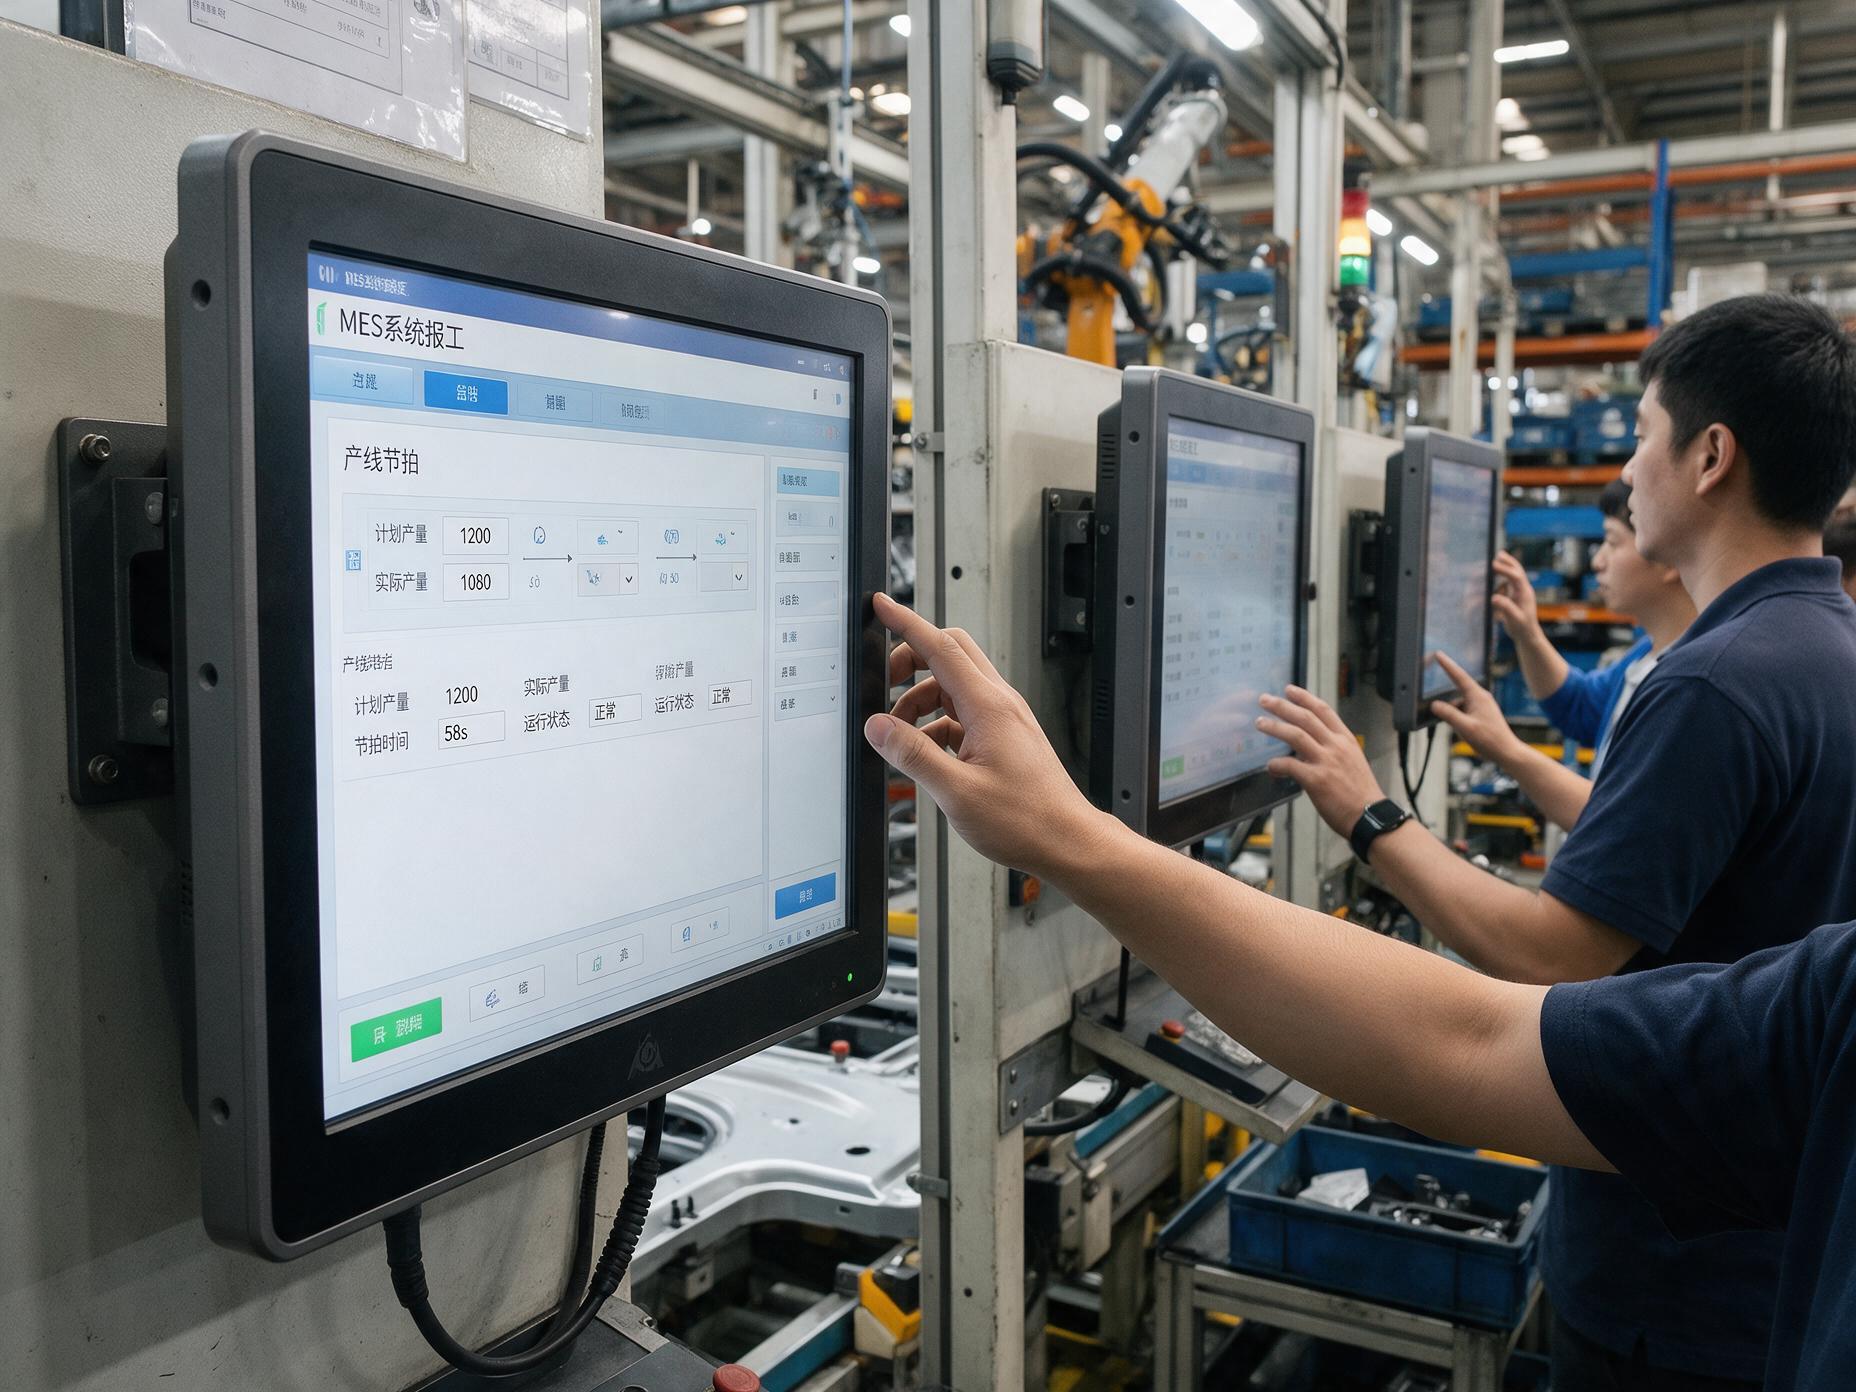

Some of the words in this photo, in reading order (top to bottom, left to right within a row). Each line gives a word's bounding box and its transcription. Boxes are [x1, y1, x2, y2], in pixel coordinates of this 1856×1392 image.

[340, 308, 465, 350] MES系统报工
[344, 444, 419, 475] 产线节拍
[375, 523, 428, 544] 计划产量
[460, 527, 491, 544] 1200
[375, 571, 428, 593] 实际产量
[461, 573, 492, 591] 1080
[354, 692, 410, 716] 计划产量
[445, 685, 479, 705] 1200
[524, 674, 570, 697] 实际产量
[654, 692, 695, 715] 运行状态
[711, 686, 731, 705] 正常
[523, 709, 571, 733] 运行状态
[594, 701, 616, 721] 正常
[354, 731, 409, 757] 节拍时间
[444, 724, 468, 742] 58s
